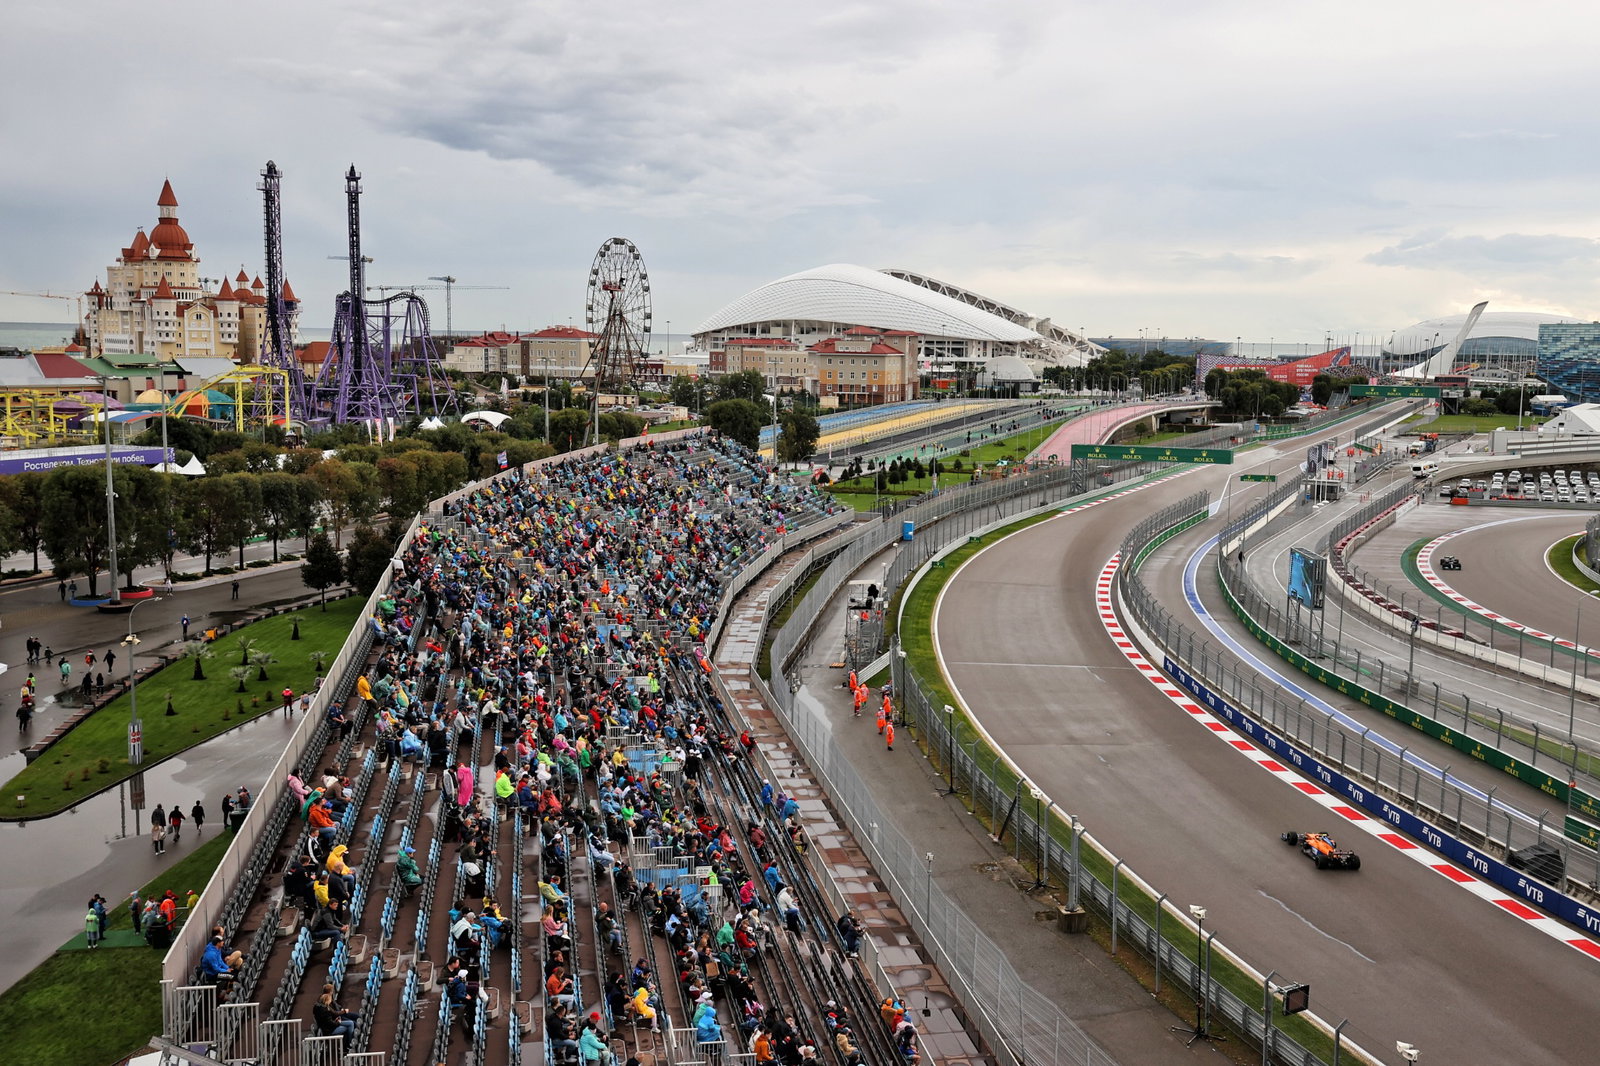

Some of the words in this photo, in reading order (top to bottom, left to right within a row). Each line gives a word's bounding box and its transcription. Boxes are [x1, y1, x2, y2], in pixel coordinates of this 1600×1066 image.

[122, 454, 145, 462] побед
[1245, 720, 1253, 734] VTB
[1268, 736, 1276, 750] VTB
[1440, 734, 1453, 745] ROLEX
[1292, 751, 1302, 766] VTB
[1471, 749, 1485, 760] ROLEX
[1320, 766, 1331, 784] VTB
[1504, 765, 1519, 777] ROLEX
[1352, 786, 1364, 803] VTB
[1540, 784, 1557, 796] ROLEX
[1388, 808, 1400, 824] VTB
[1581, 804, 1598, 817] ROLEX
[1428, 832, 1442, 848] VTB
[1580, 835, 1598, 848] ROLE
[1472, 856, 1488, 874] VTB
[1524, 884, 1544, 903] VTB
[1586, 913, 1600, 933] VT
